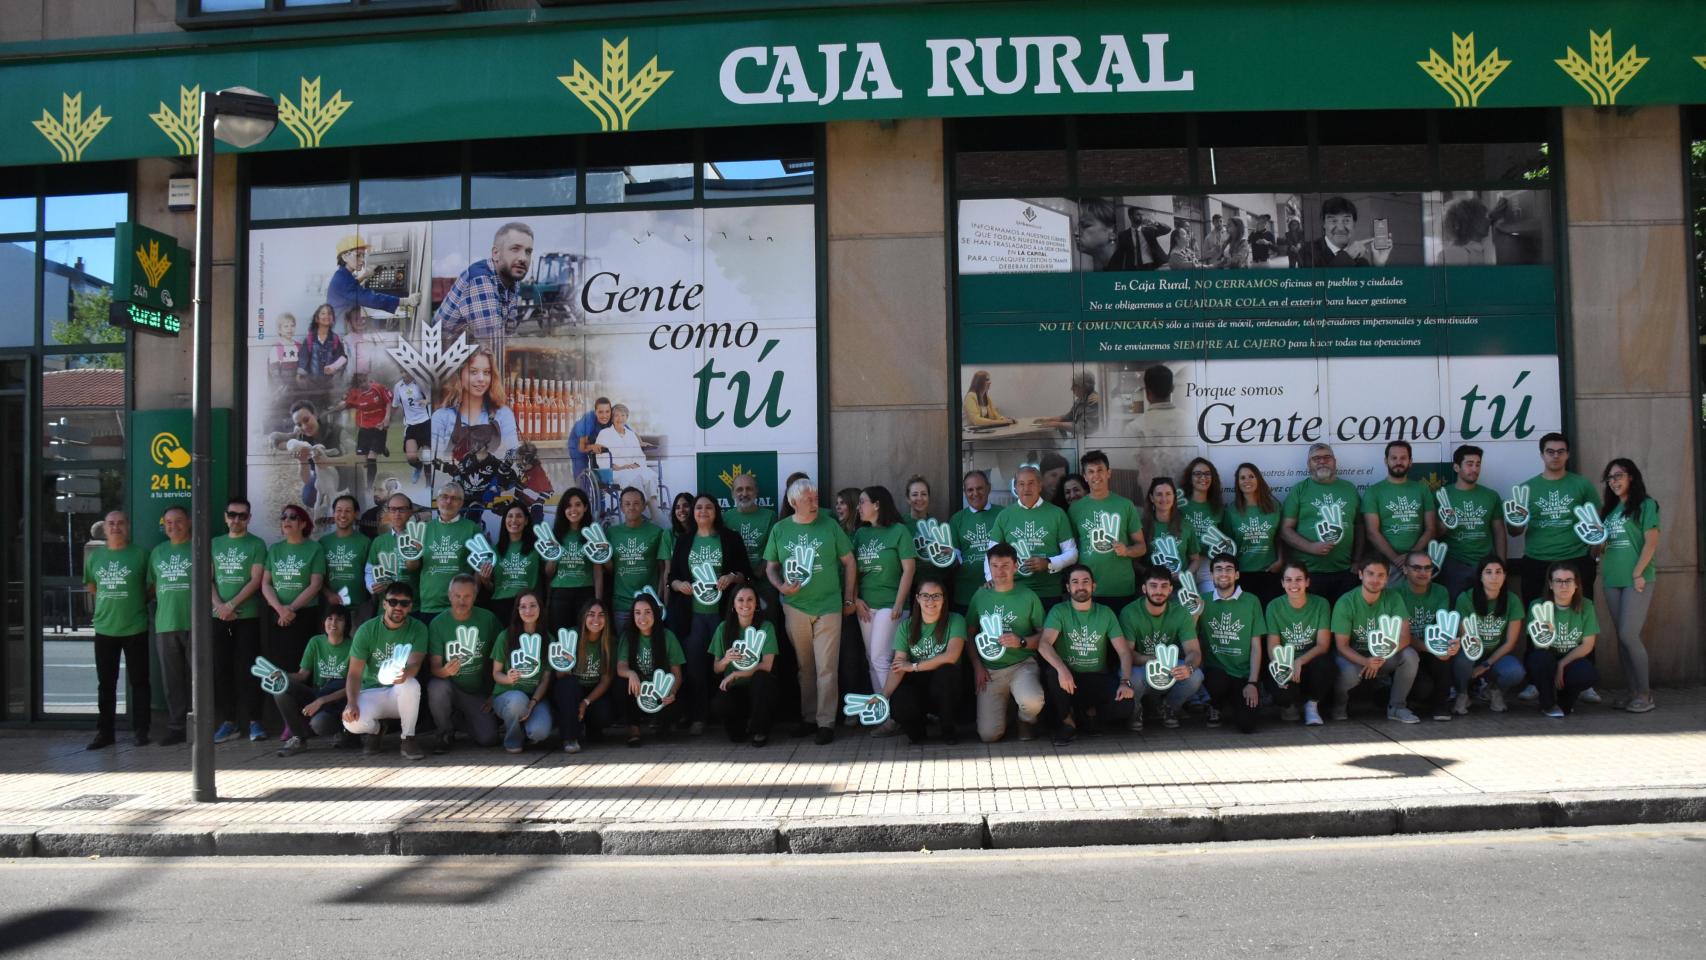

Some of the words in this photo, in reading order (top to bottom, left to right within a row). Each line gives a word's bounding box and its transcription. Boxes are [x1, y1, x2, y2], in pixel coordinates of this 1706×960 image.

[719, 43, 903, 105] CAJA
[926, 33, 1194, 97] RURAL
[134, 284, 148, 299] 24h
[581, 272, 704, 314] Gente
[1114, 281, 1127, 291] En
[1129, 279, 1155, 292] Caja
[1159, 278, 1191, 292] Rural,
[1195, 280, 1213, 290] NO
[1215, 278, 1278, 289] CERRAMOS
[1280, 278, 1312, 289] oficinas
[1315, 279, 1325, 287] en
[1327, 277, 1358, 289] pueblos
[1359, 279, 1365, 289] y
[1367, 277, 1403, 287] ciudades
[1089, 300, 1103, 310] No
[1104, 301, 1112, 310] te
[1114, 299, 1164, 311] obligaremos
[1166, 301, 1172, 309] a
[1174, 298, 1232, 309] GUARDAR
[1235, 298, 1266, 308] COLA
[1268, 299, 1279, 307] en
[1280, 297, 1288, 307] el
[1290, 297, 1322, 307] exterior
[1346, 296, 1369, 306] hacer
[1370, 296, 1407, 307] gestiones
[1039, 322, 1057, 332] NO
[1059, 321, 1073, 331] TE
[1077, 317, 1164, 331] COMUNICARÁS
[1165, 319, 1182, 329] sólo
[1183, 321, 1190, 329] a
[1217, 318, 1228, 328] de
[1229, 318, 1254, 329] móvil,
[1256, 317, 1301, 328] ordenador,
[1303, 317, 1360, 329] teleoperadores
[1362, 316, 1415, 328] impersonales
[1416, 318, 1422, 328] y
[1423, 316, 1478, 326] desmotivados
[649, 321, 759, 350] como
[1099, 341, 1112, 351] No
[1114, 342, 1122, 351] te
[1124, 340, 1171, 351] enviaremos
[1173, 339, 1223, 350] SIEMPRE
[1225, 339, 1240, 349] AL
[1243, 338, 1286, 349] CAJERO
[1288, 339, 1307, 349] para
[1335, 337, 1357, 347] todas
[1359, 337, 1372, 346] tus
[1374, 336, 1421, 348] operaciones
[693, 339, 791, 429] tú
[1186, 381, 1236, 400] Porque
[1240, 384, 1284, 397] somos
[1198, 402, 1323, 444] Gente
[1336, 414, 1446, 443] como
[1459, 370, 1536, 441] tú
[151, 474, 170, 490] 24
[175, 473, 192, 490] h.
[163, 490, 192, 498] servicio
